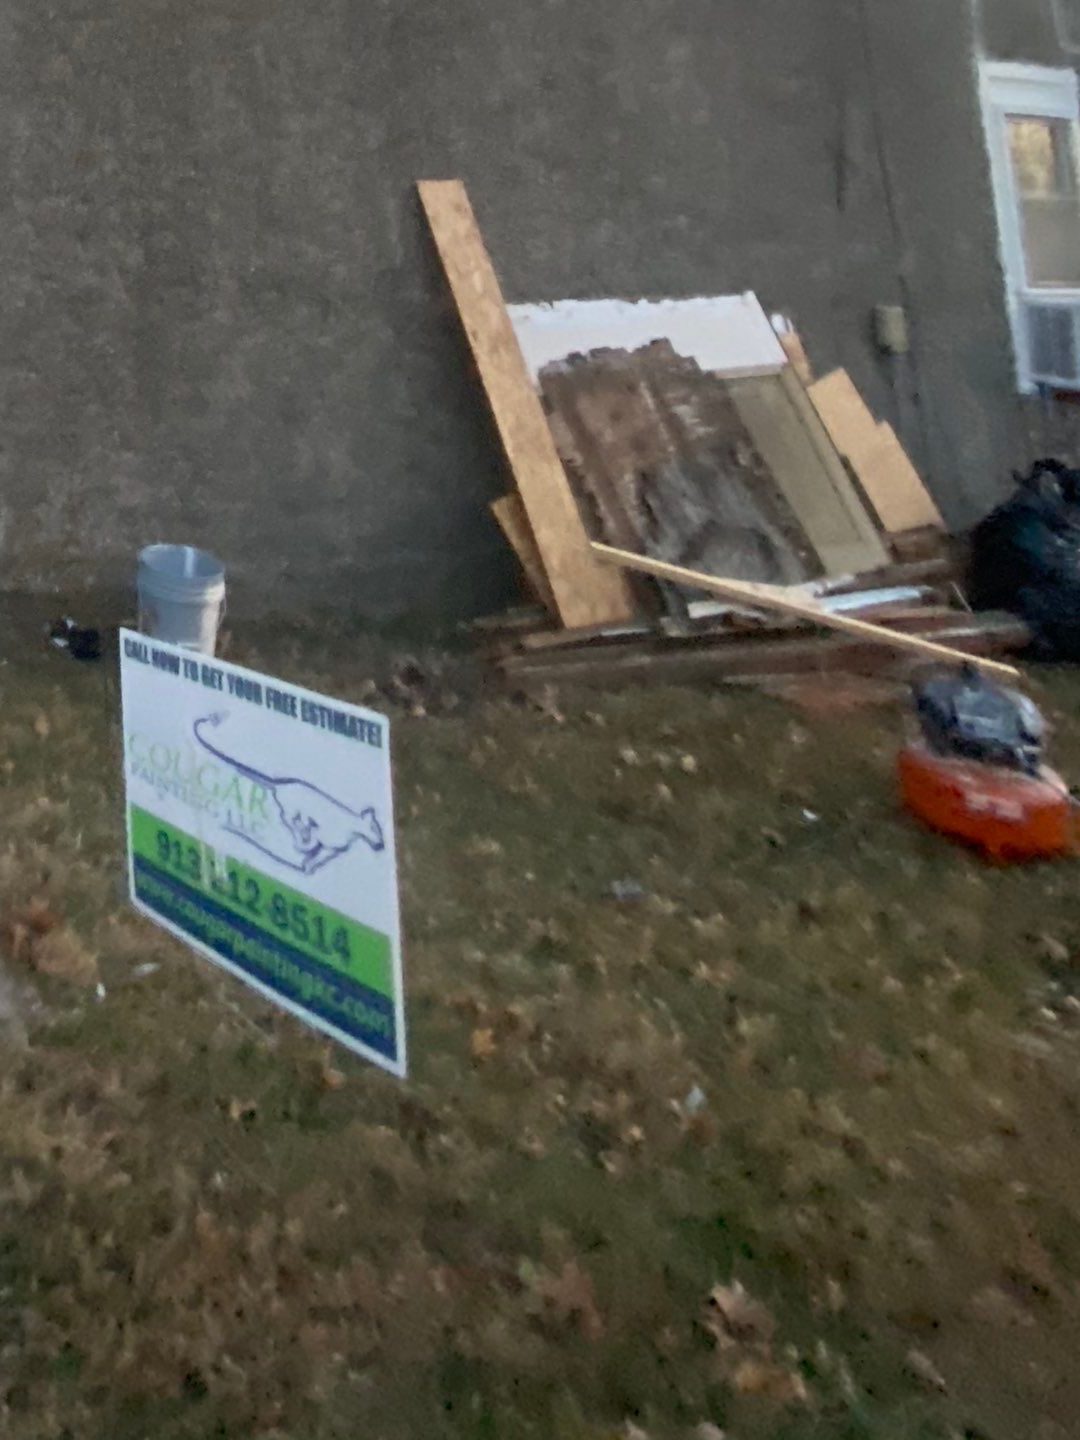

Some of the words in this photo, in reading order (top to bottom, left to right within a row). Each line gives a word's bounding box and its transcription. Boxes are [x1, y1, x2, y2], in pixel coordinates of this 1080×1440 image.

[124, 638, 149, 665] CALL
[151, 647, 180, 676] NOW
[182, 657, 199, 682] TO
[201, 662, 224, 691] GET
[226, 672, 263, 706] YOUR
[266, 686, 297, 718] FREE
[300, 697, 382, 749] ESTIMATE!
[128, 732, 270, 820] COUGAR
